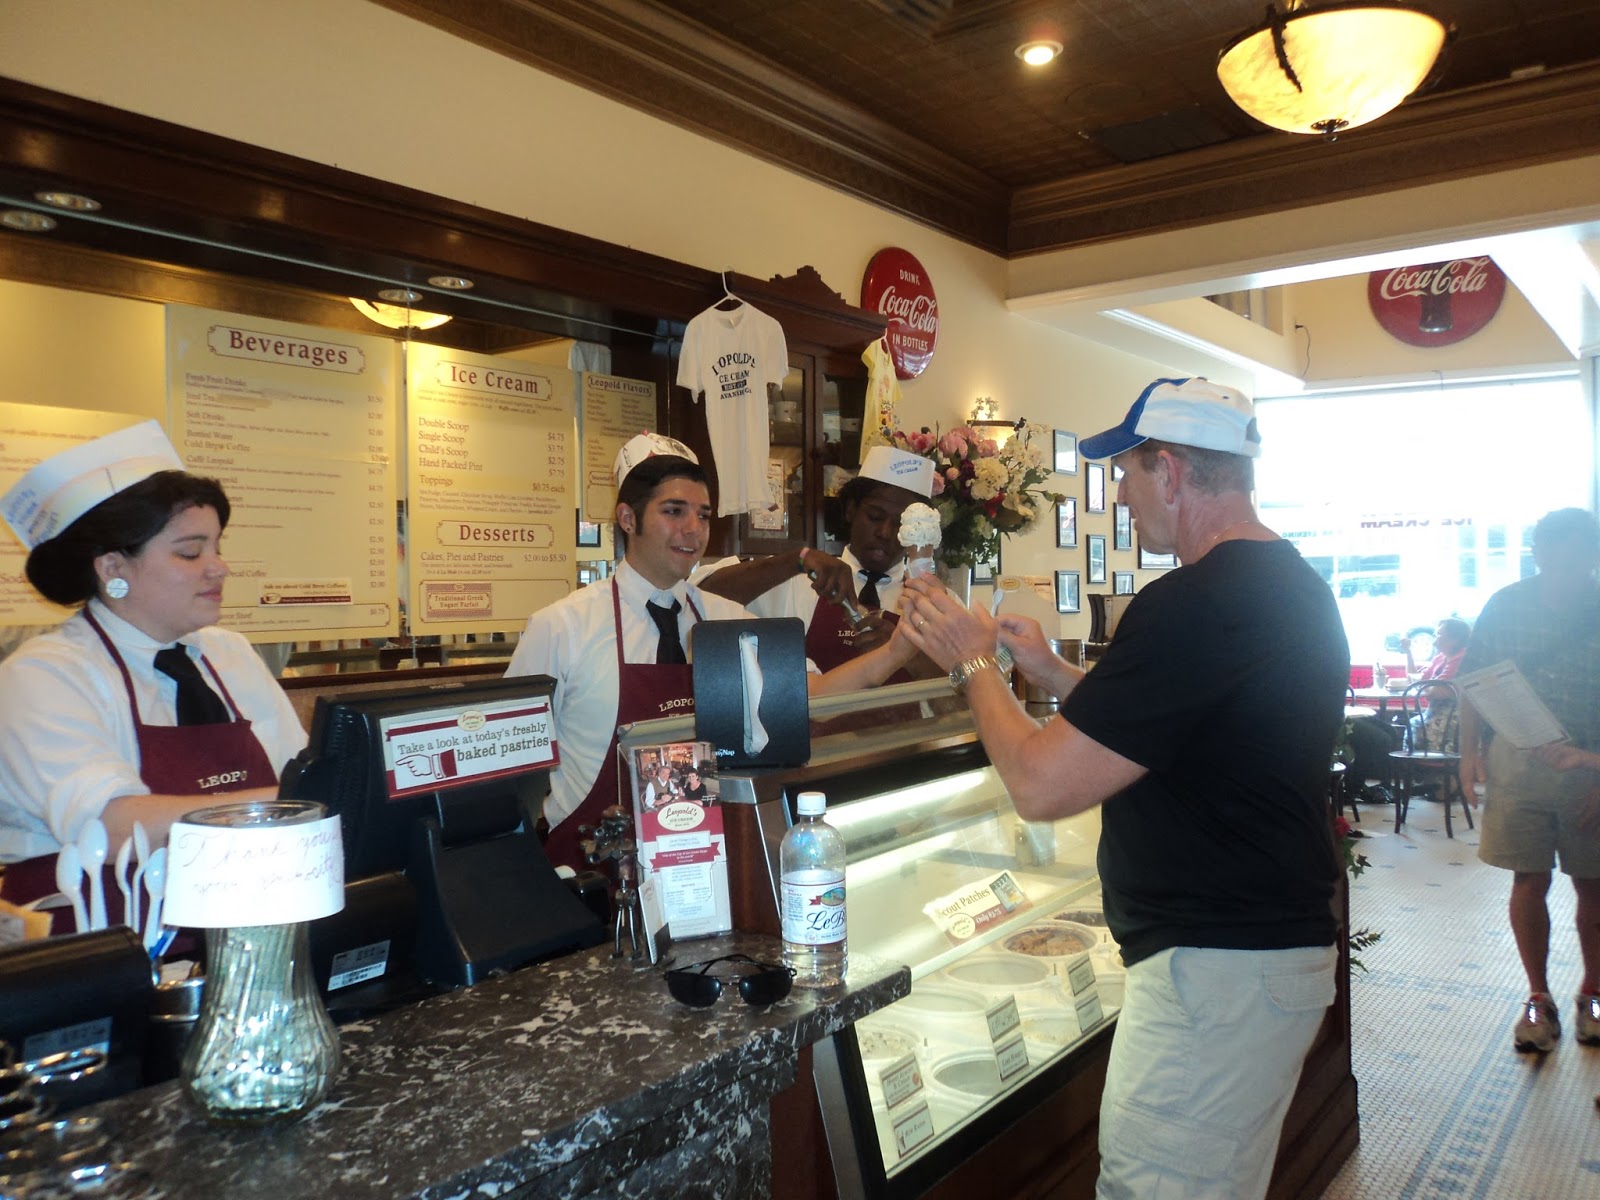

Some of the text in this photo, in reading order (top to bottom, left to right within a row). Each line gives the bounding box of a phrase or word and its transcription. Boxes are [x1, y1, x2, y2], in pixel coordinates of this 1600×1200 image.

[899, 269, 920, 286] DRINK
[1380, 257, 1491, 300] Coca-Cola
[879, 285, 937, 334] Coca-Cola
[229, 330, 348, 366] Beverages
[892, 333, 928, 351] IN BOTTLES
[451, 365, 539, 395] Ice Cream
[590, 378, 651, 395] Leopold Flavors
[418, 416, 470, 432] Double Scoop
[418, 430, 465, 445] Single Scoop
[547, 431, 565, 442] $4.75
[418, 443, 468, 458] Child's Scoop
[418, 457, 483, 472] Hand Packed Pint
[548, 455, 565, 466] $2.75
[419, 474, 453, 487] Toppings
[550, 484, 565, 493] each
[459, 524, 535, 543] Desserts
[446, 552, 460, 561] Pies
[463, 552, 476, 561] and
[477, 552, 504, 562] Pastries
[541, 554, 548, 562] to
[397, 722, 547, 756] Take a look at today's freshly
[456, 736, 549, 762] baked pastries
[665, 807, 697, 819] Leopold's
[960, 887, 991, 907] Patches
